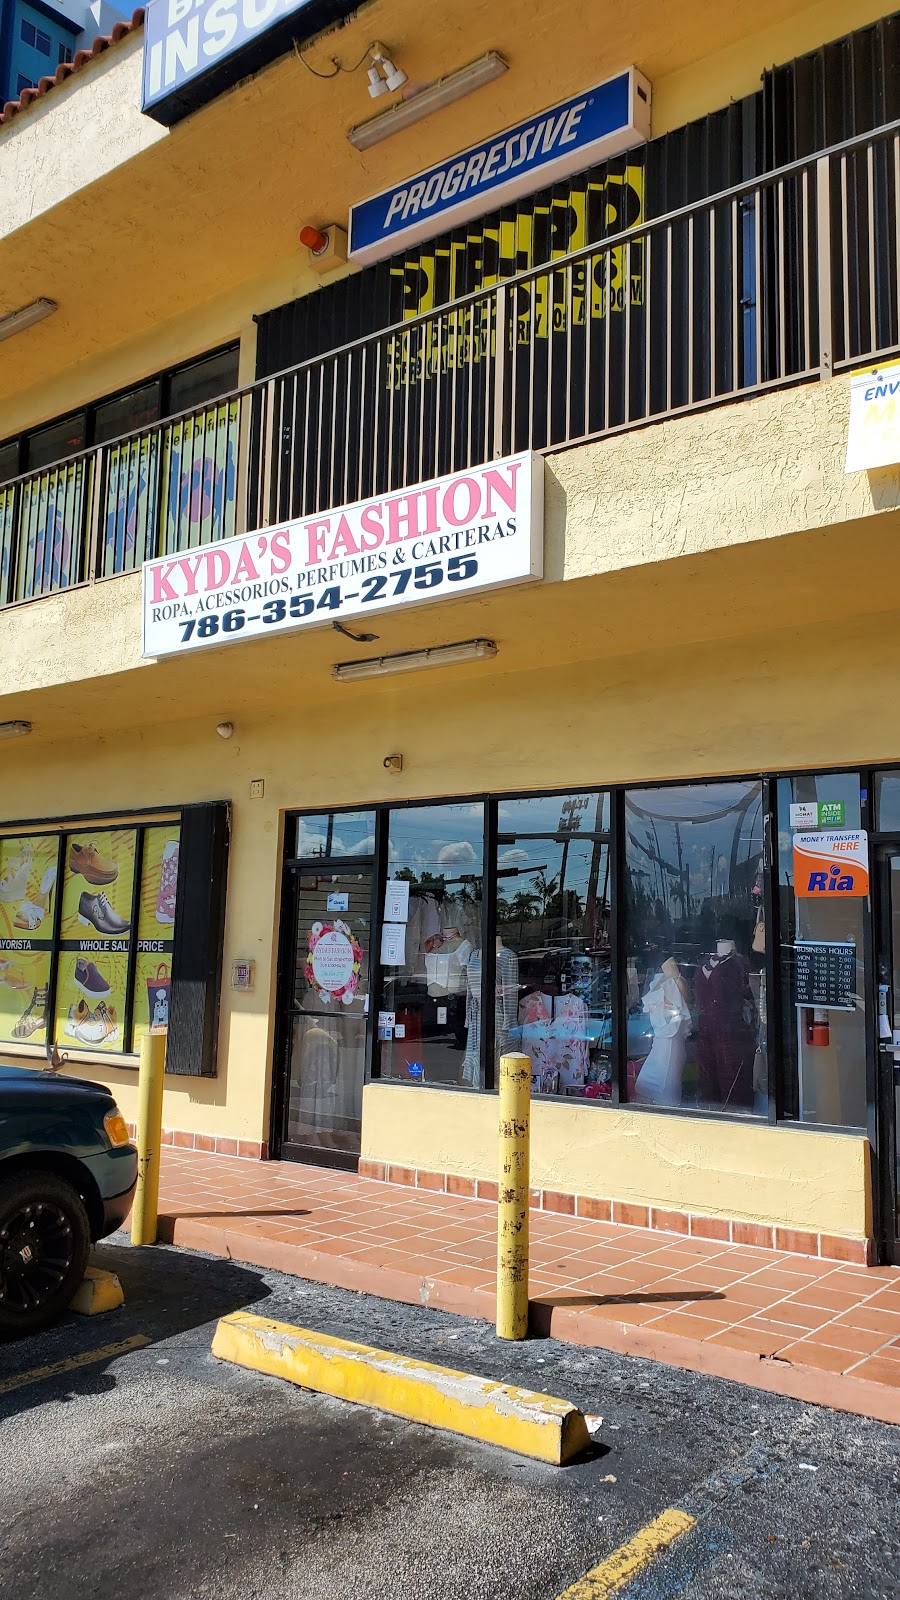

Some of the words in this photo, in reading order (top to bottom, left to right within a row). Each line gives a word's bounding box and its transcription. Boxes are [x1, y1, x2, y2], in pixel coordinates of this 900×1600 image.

[383, 101, 588, 228] PROGRESSIVE
[864, 380, 900, 401] ENV
[150, 529, 292, 604] KYDA'S
[304, 463, 522, 567] FASHION
[152, 602, 192, 623] ROPA,
[196, 576, 293, 614] ACESSORIOS,
[297, 551, 387, 589] PERFUMES
[392, 547, 406, 566] &
[411, 517, 517, 560] CARTERAS
[178, 552, 479, 643] 786-354-2755
[800, 835, 824, 843] MONEY
[826, 834, 860, 842] TRANSFER
[832, 842, 860, 851] HERE
[807, 864, 854, 891] Ria
[80, 940, 108, 951] WHOLE
[111, 940, 130, 951] SAL
[137, 941, 164, 952] PRICE
